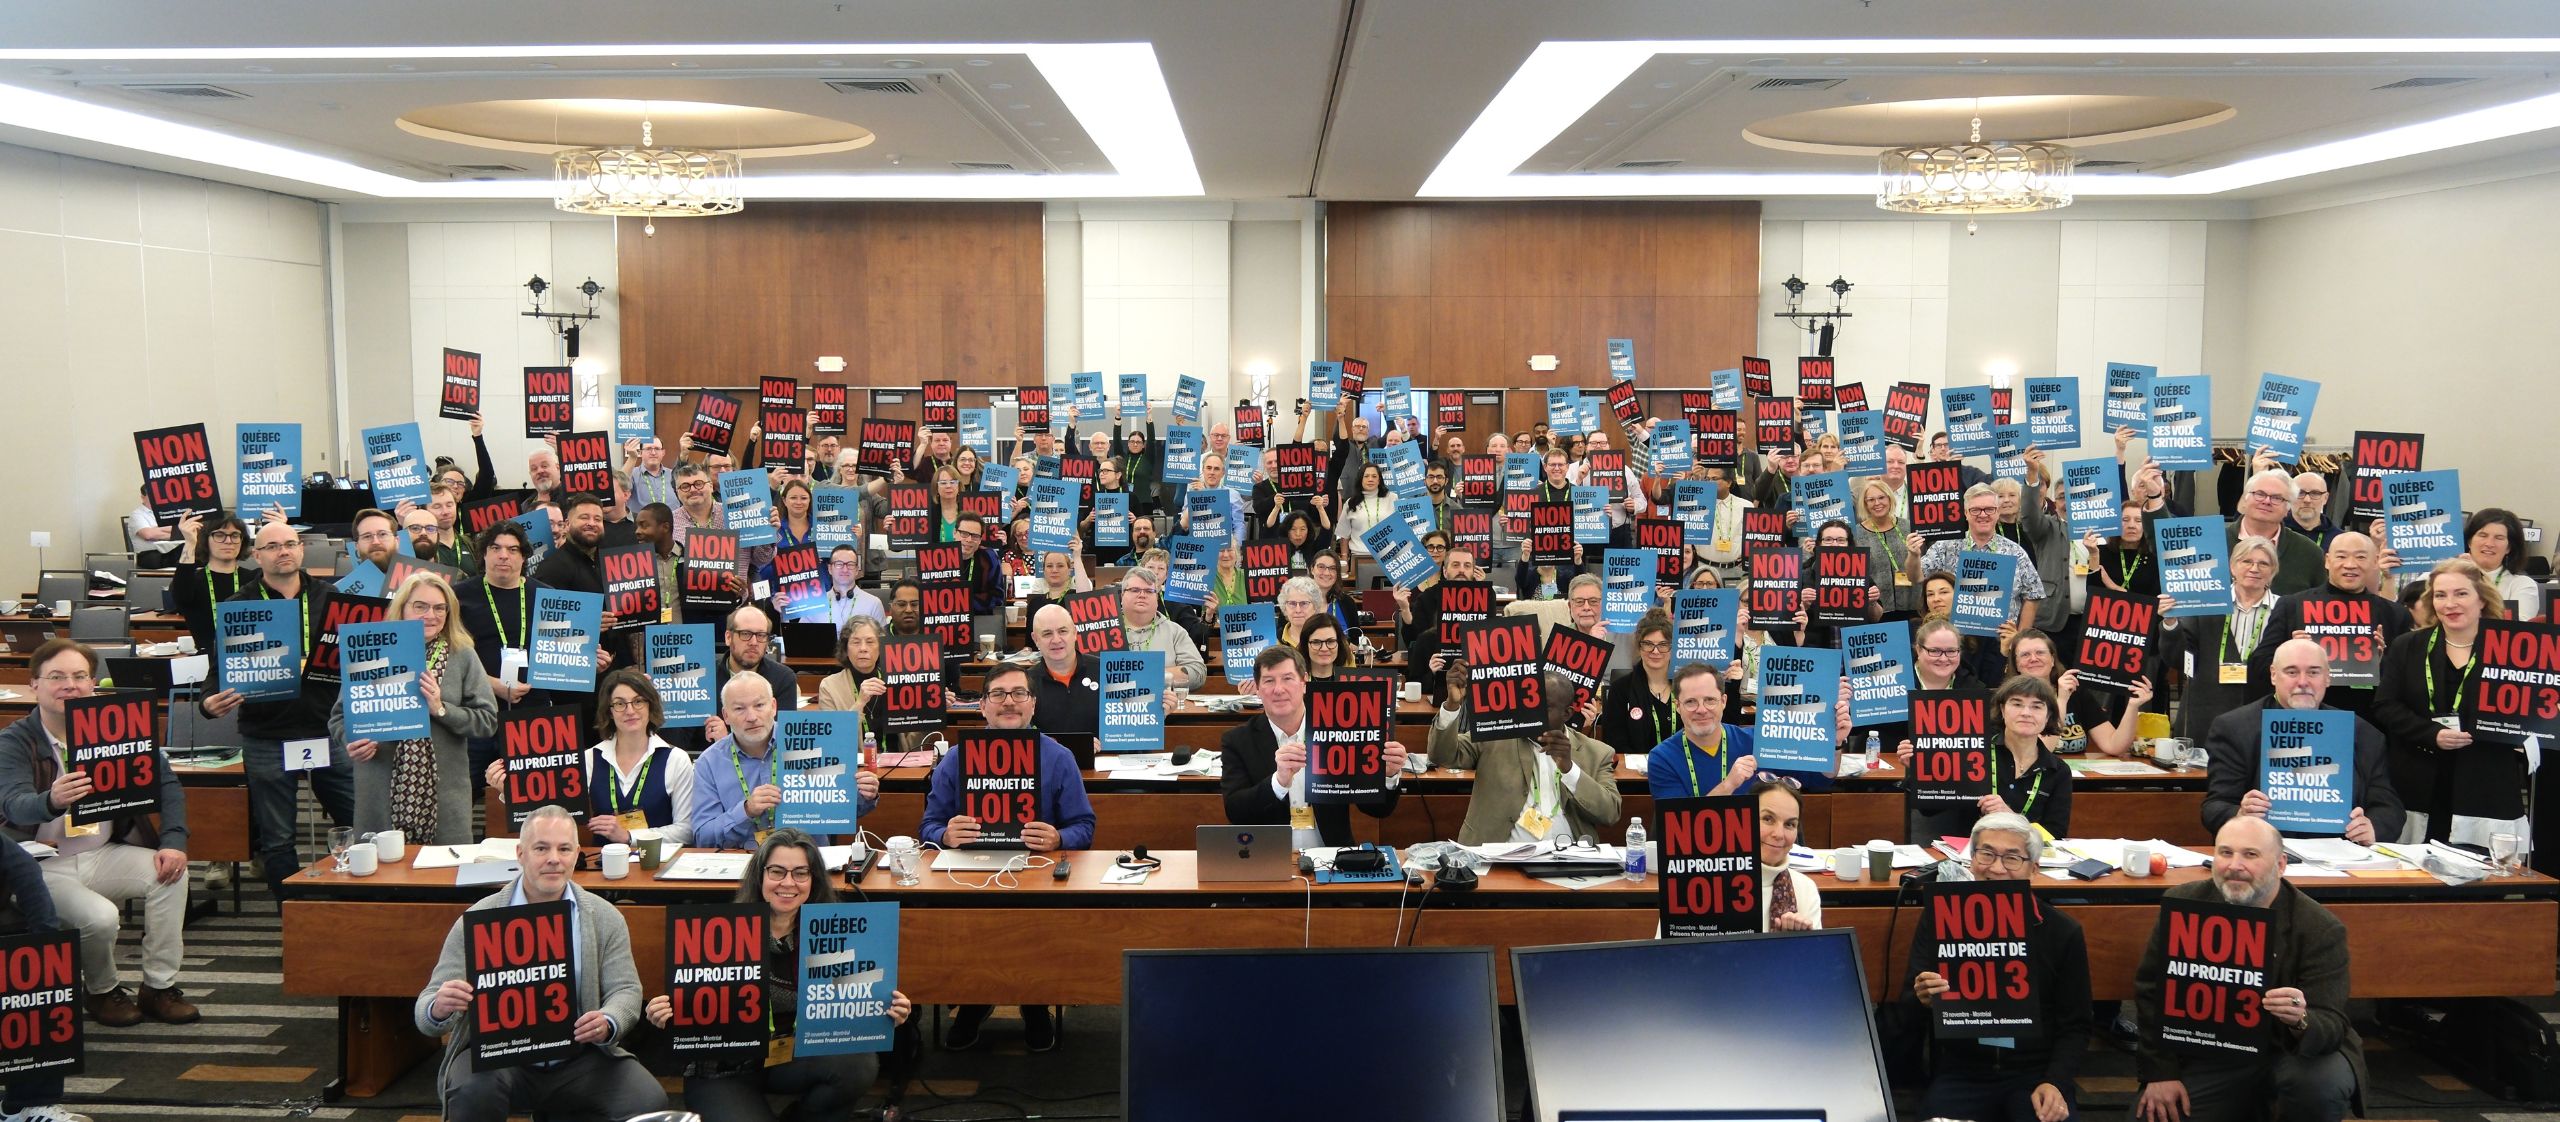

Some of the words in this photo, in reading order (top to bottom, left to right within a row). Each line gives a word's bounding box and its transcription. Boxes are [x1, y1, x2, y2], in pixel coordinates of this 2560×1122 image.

[528, 373, 569, 394] NON
[2154, 383, 2191, 397] QUÉBEC
[925, 385, 954, 400] NON
[1439, 393, 1463, 406] NON
[1758, 401, 1791, 419] NON
[2153, 397, 2178, 408] VEUT
[529, 404, 555, 421] LOI
[559, 403, 570, 421] 3
[242, 429, 281, 443] QUÉBEC
[1759, 427, 1779, 441] LOI
[1783, 427, 1791, 441] 3
[2153, 425, 2170, 436] SES
[2172, 425, 2195, 435] VOIX
[142, 432, 205, 467] NON
[242, 444, 268, 454] VEUT
[2153, 437, 2204, 448] CRITIQUES.
[149, 468, 162, 479] AU
[162, 463, 194, 477] PROJET
[195, 461, 208, 472] DE
[243, 473, 261, 483] SES
[262, 472, 286, 483] VOIX
[151, 477, 192, 504] LOI
[195, 474, 212, 497] 3
[243, 484, 296, 495] CRITIQUES.
[1037, 484, 1065, 495] QUÉBEC
[2389, 479, 2434, 495] QUÉBEC
[1036, 493, 1055, 503] VEUT
[2389, 494, 2420, 506] VEUT
[1034, 515, 1047, 524] SES
[1048, 516, 1065, 526] VOIX
[1534, 506, 1570, 526] NON
[2392, 525, 2414, 536] SES
[2415, 523, 2443, 535] VOIX
[1535, 535, 1558, 550] LOI
[1561, 534, 1571, 550] 3
[2393, 535, 2457, 549] CRITIQUES.
[1820, 553, 1865, 577] NON
[1820, 577, 1830, 586] AU
[1830, 578, 1856, 586] PROJET
[1856, 578, 1865, 586] DE
[1820, 587, 1848, 607] LOI
[1853, 588, 1864, 608] 3
[347, 630, 398, 648] QUÉBEC
[348, 648, 382, 663] VEUT
[885, 642, 939, 673] NON
[1766, 655, 1814, 673] QUÉBEC
[887, 675, 898, 684] AU
[899, 673, 929, 684] PROJET
[929, 672, 940, 682] DE
[1766, 673, 1797, 687] VEUT
[350, 685, 374, 699] SES
[376, 682, 406, 696] VOIX
[887, 685, 921, 710] LOI
[927, 684, 941, 708] 3
[351, 696, 421, 713] CRITIQUES.
[1313, 692, 1380, 728] NON
[1762, 709, 1786, 723] SES
[1787, 710, 1817, 725] VOIX
[1915, 699, 1984, 735] NON
[2270, 717, 2323, 734] QUÉBEC
[784, 719, 832, 736] QUÉBEC
[1312, 731, 1327, 742] AU
[1328, 730, 1366, 742] PROJET
[1367, 730, 1380, 741] DE
[1762, 724, 1828, 741] CRITIQUES.
[784, 738, 815, 750] VEUT
[1916, 737, 1931, 749] AU
[1932, 737, 1970, 749] PROJET
[1971, 737, 1984, 748] DE
[2270, 735, 2304, 749] VEUT
[303, 748, 312, 760] 2
[1312, 745, 1355, 774] LOI
[1363, 745, 1379, 774] 3
[1916, 752, 1960, 781] LOI
[1967, 752, 1985, 781] 3
[783, 774, 806, 788] SES
[808, 774, 837, 787] VOIX
[2269, 772, 2294, 785] SES
[2296, 773, 2329, 787] VOIX
[783, 790, 849, 804] CRITIQUES.
[2269, 786, 2343, 802] CRITIQUES.
[1665, 808, 1752, 855] NON
[1667, 859, 1685, 874] AU
[1687, 857, 1734, 873] PROJET
[1736, 856, 1753, 871] DE
[1668, 877, 1722, 913] LOI
[1732, 875, 1754, 911] 3
[809, 913, 868, 936] QUÉBEC
[1934, 893, 2025, 939] NON
[474, 914, 565, 970] NON
[674, 916, 761, 964] NON
[808, 937, 847, 954] VEUT
[2168, 911, 2266, 967] NON
[1937, 943, 1956, 958] AU
[1958, 942, 2007, 958] PROJET
[2009, 942, 2027, 956] DE
[477, 972, 496, 989] AU
[498, 965, 547, 986] PROJET
[549, 963, 566, 979] DE
[674, 968, 693, 983] AU
[695, 966, 743, 982] PROJET
[744, 965, 761, 980] DE
[2005, 961, 2029, 999] 3
[2167, 960, 2188, 976] AU
[2189, 963, 2242, 983] PROJET
[2243, 970, 2262, 986] DE
[807, 984, 835, 1001] SES
[837, 982, 872, 999] VOIX
[477, 987, 536, 1031] LOI
[545, 983, 568, 1021] 3
[674, 986, 729, 1024] LOI
[739, 984, 760, 1022] 3
[2166, 979, 2226, 1022] LOI
[2235, 989, 2259, 1026] 3
